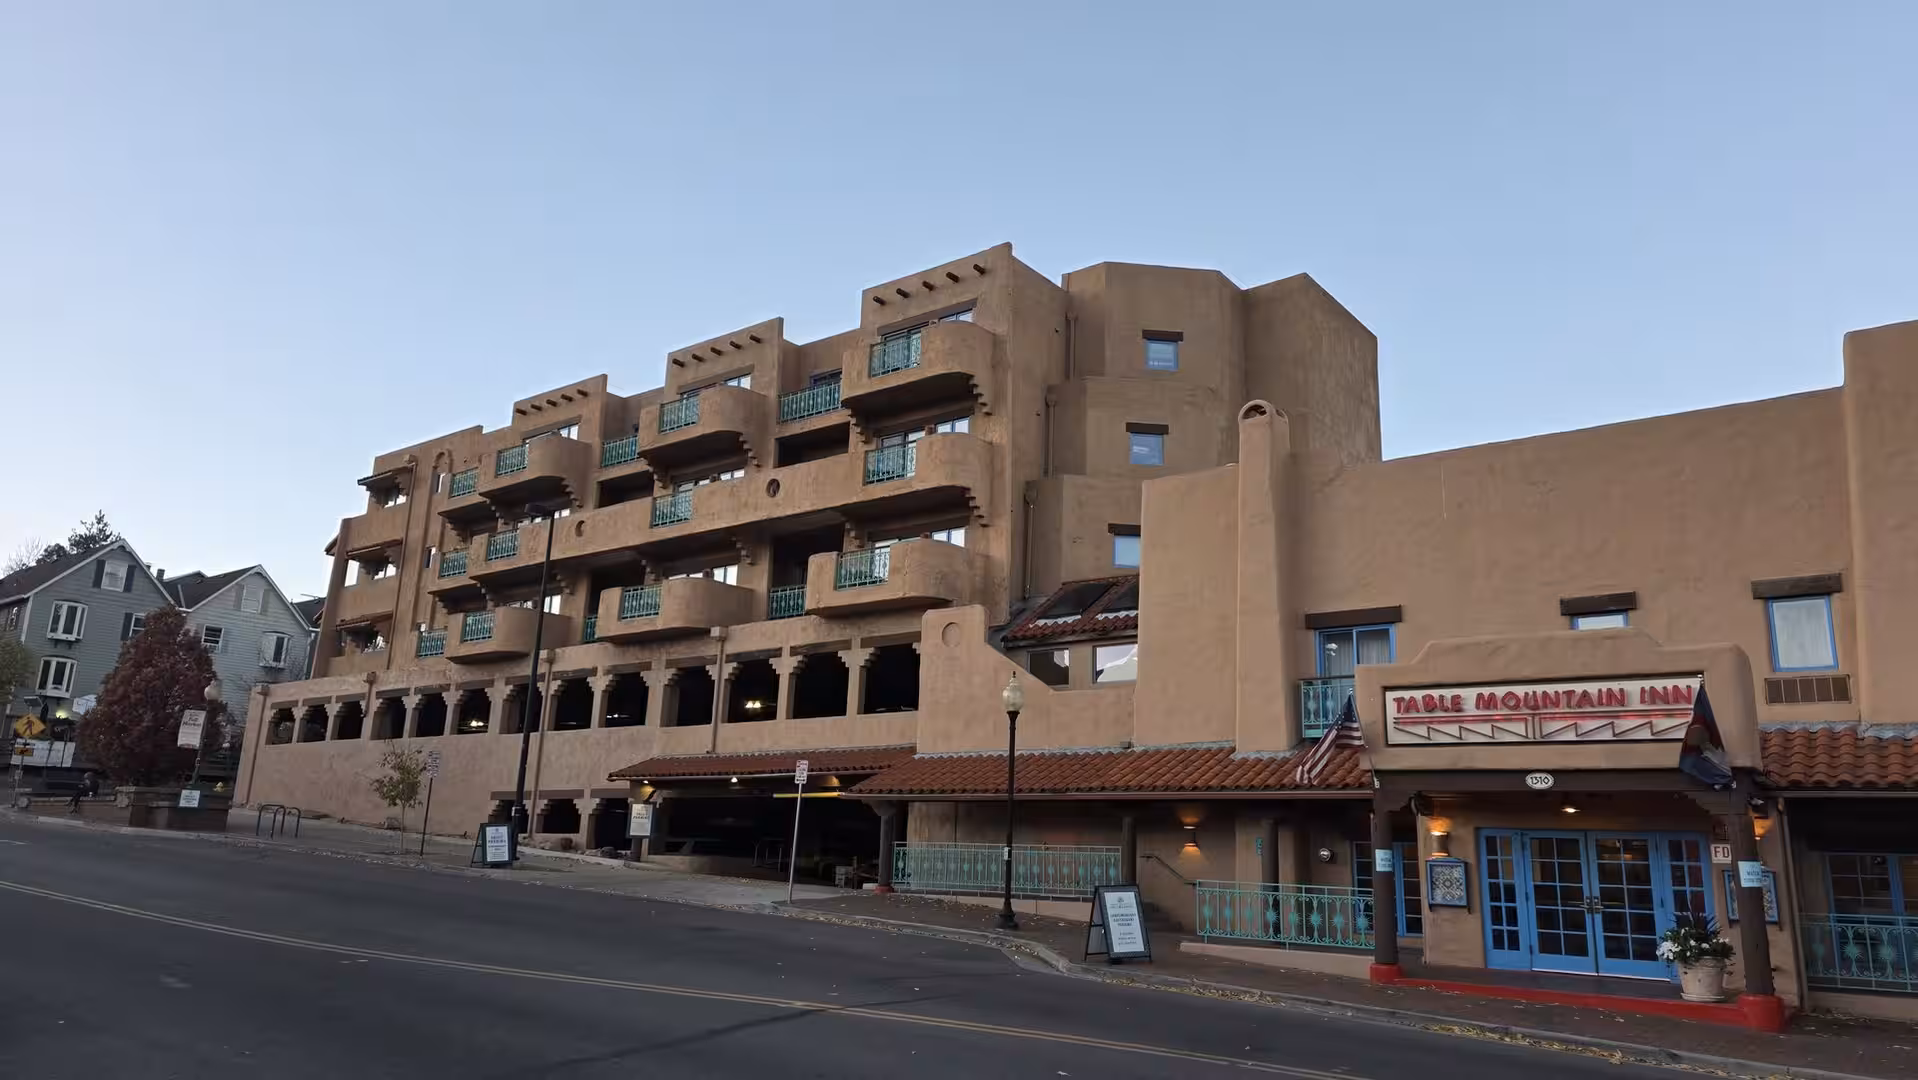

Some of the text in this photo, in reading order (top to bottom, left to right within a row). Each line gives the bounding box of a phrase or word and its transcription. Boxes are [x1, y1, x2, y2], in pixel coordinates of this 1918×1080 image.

[1393, 685, 1693, 714] TABLE MOUNTAIN INN
[1530, 776, 1550, 785] 1310
[1713, 846, 1730, 858] FD
